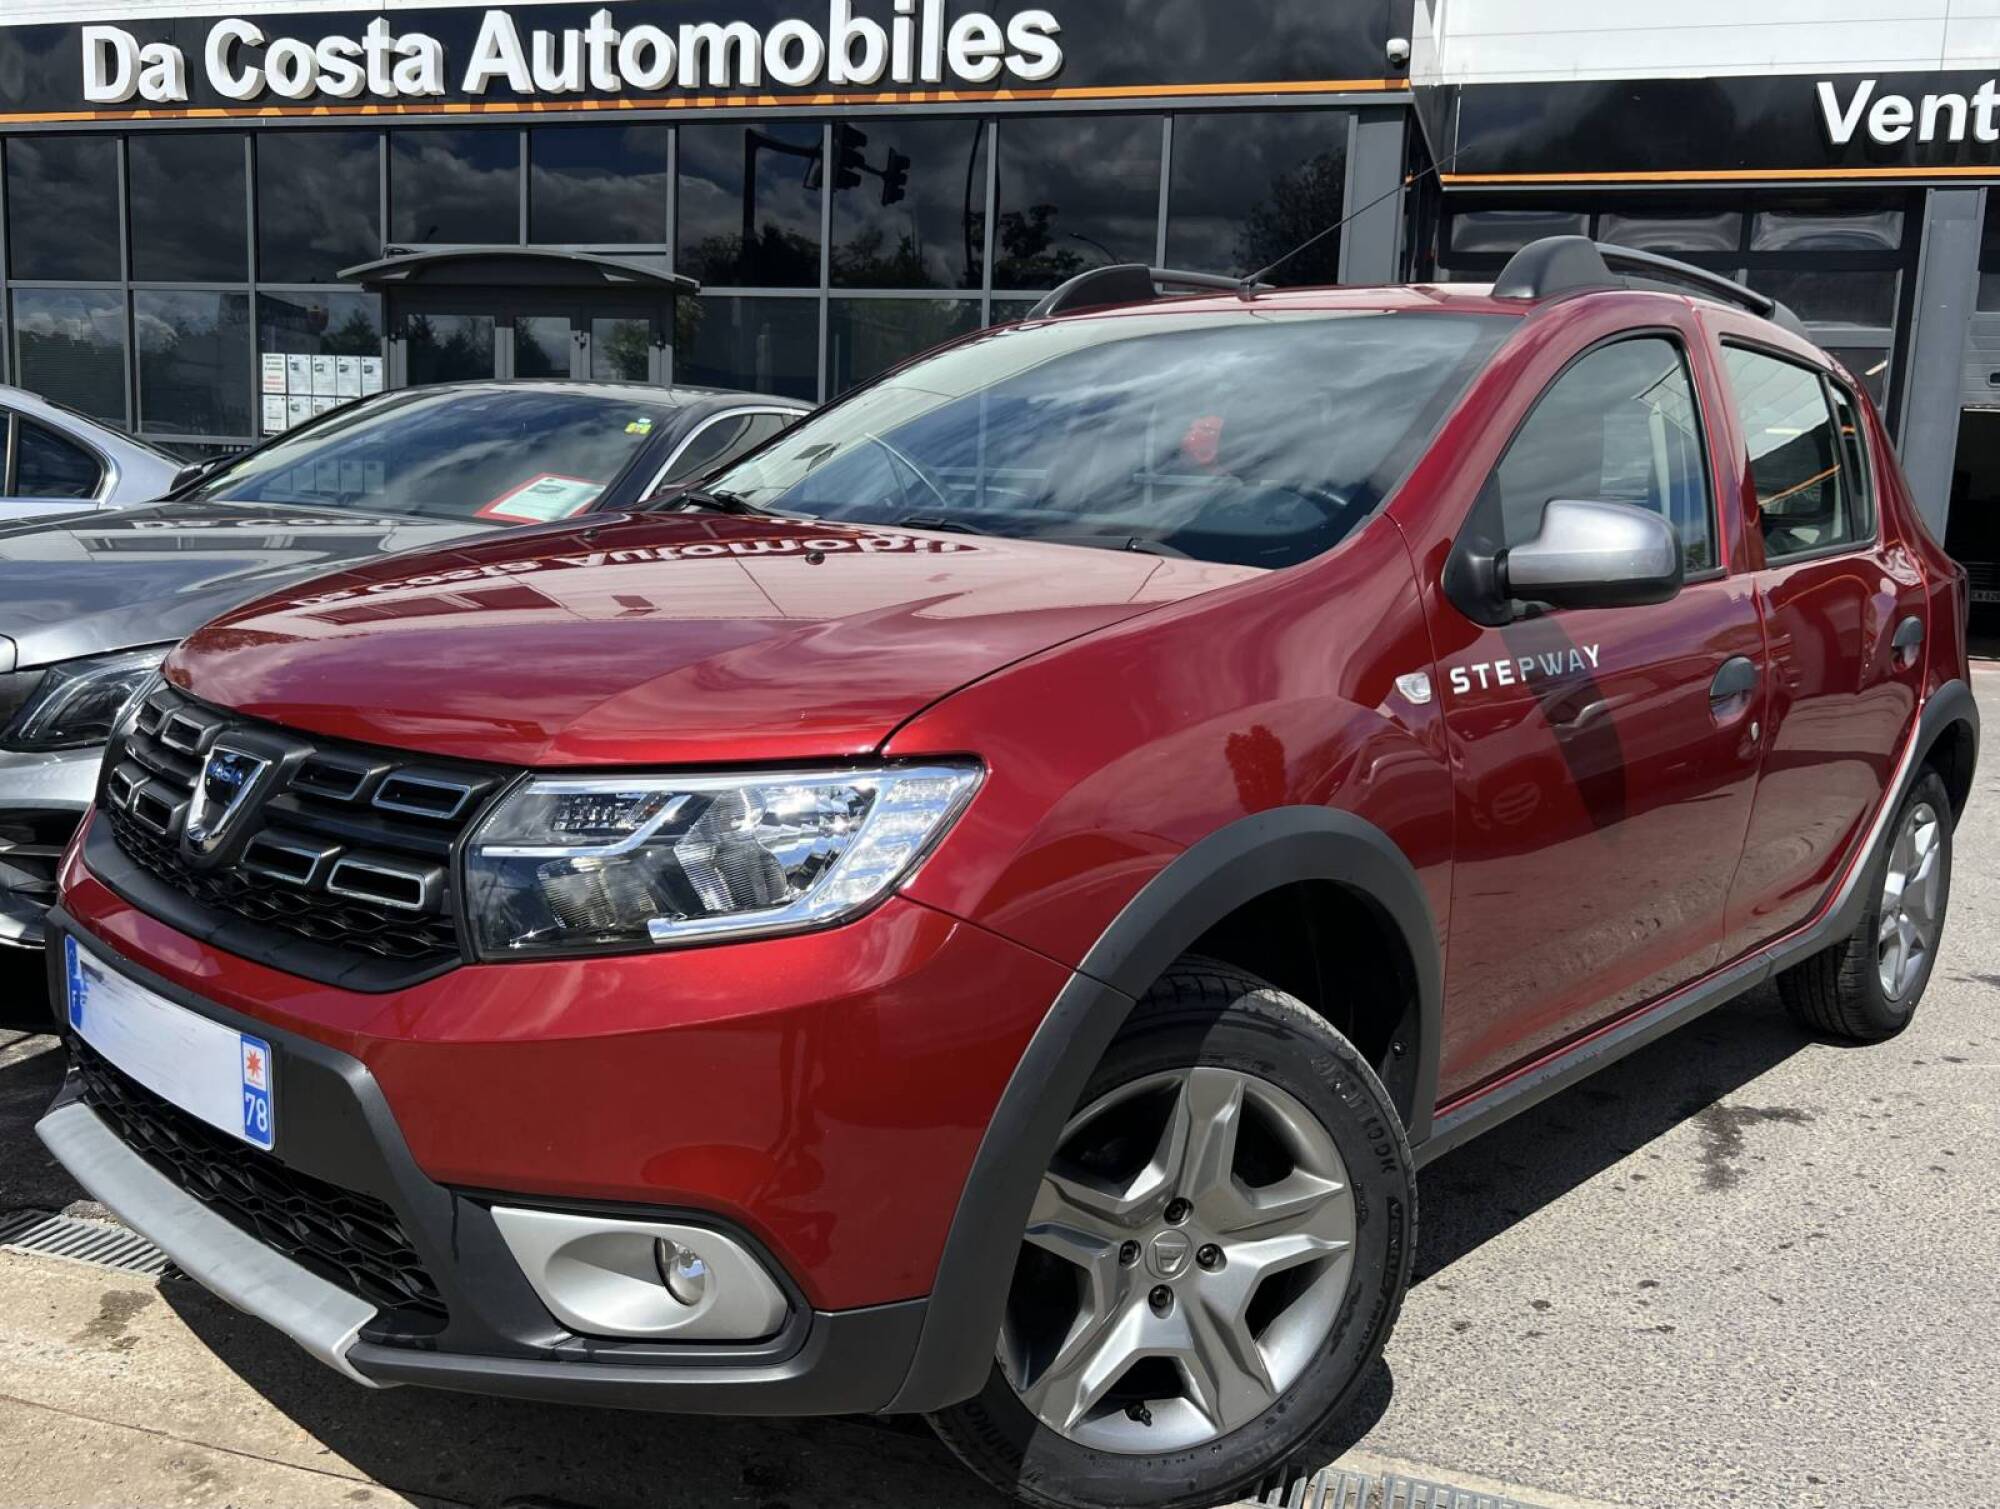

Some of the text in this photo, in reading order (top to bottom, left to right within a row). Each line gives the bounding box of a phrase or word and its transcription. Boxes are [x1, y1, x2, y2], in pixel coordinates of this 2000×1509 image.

[82, 0, 1063, 102] Da Costa Automobiles
[1816, 79, 2000, 145] Vent
[1449, 644, 1600, 695] STEPWAY
[244, 1091, 268, 1133] 78
